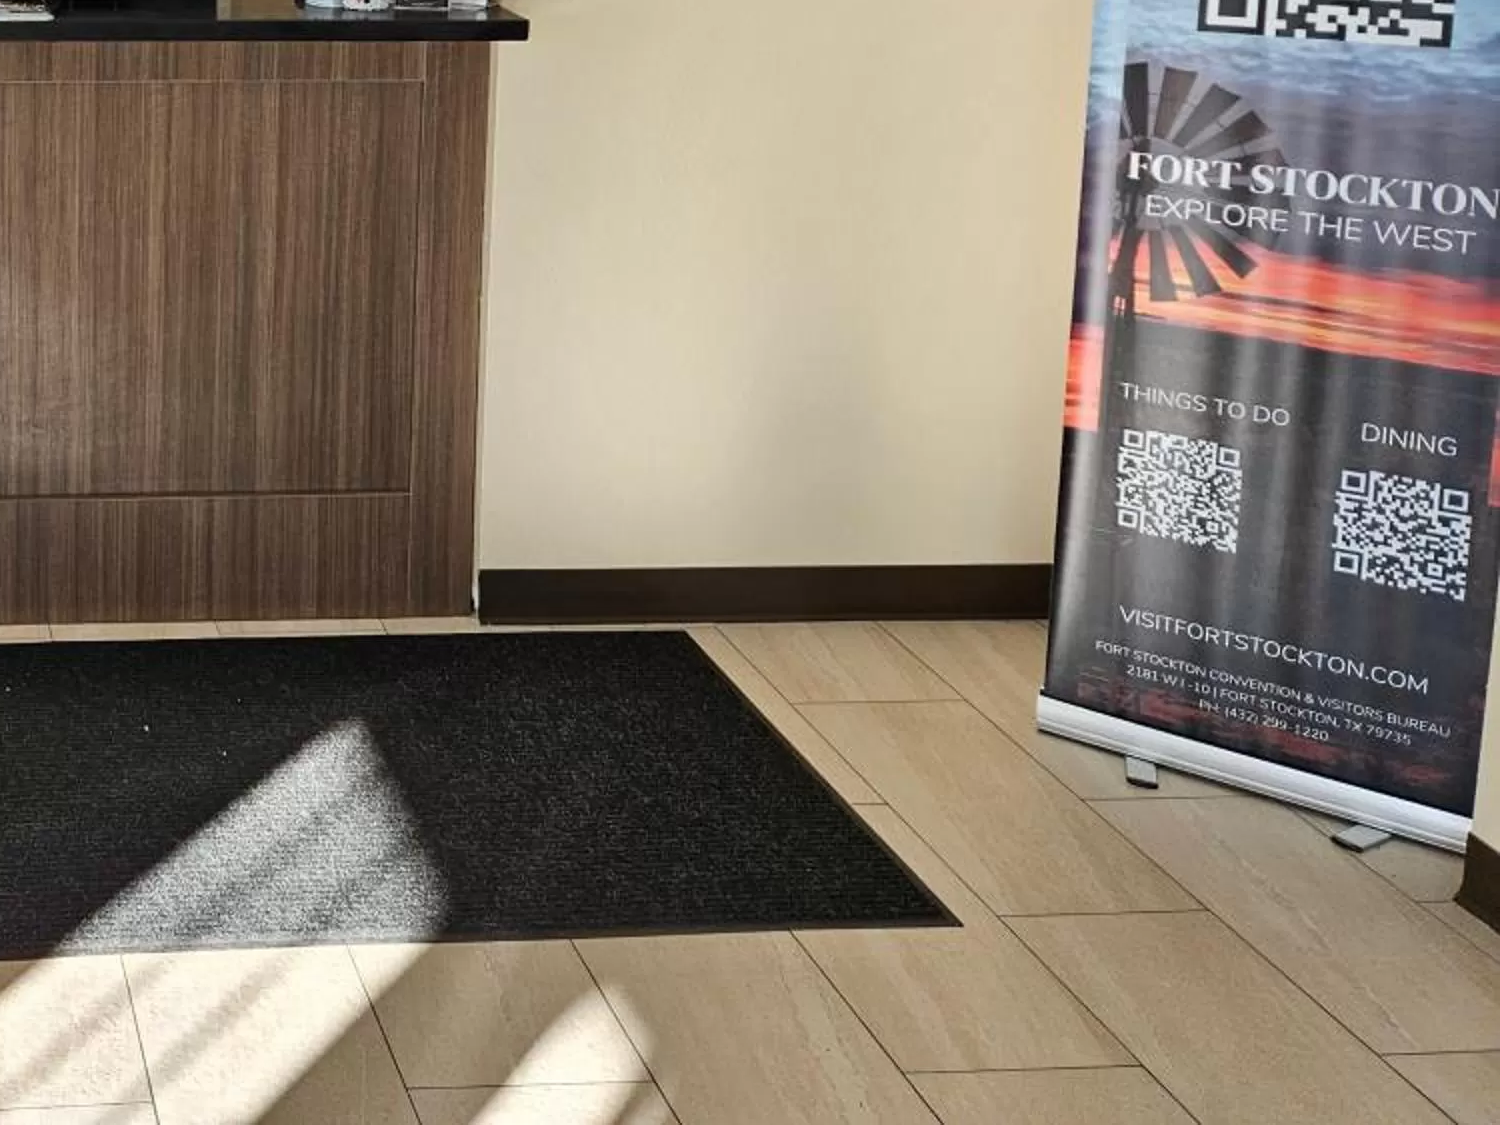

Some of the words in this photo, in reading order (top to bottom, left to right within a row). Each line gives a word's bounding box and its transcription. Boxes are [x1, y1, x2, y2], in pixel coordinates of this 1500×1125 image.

[1127, 150, 1241, 190] FORT
[1249, 163, 1500, 220] STOCKTON
[1144, 194, 1289, 233] EXPLORE
[1297, 210, 1365, 242] THE
[1373, 220, 1477, 255] WEST
[1118, 381, 1208, 413] THINGS
[1214, 397, 1247, 420] TO
[1253, 406, 1291, 427] DO
[1361, 422, 1459, 457] DINING
[1118, 604, 1429, 695] VISITFORTSTOCKTON.COM
[1095, 640, 1131, 656] FORT
[1133, 650, 1208, 676] STOCKTON
[1209, 669, 1301, 700] CONVENTION
[1317, 695, 1384, 722] VISITORS
[1387, 712, 1451, 738] BUREAU
[1219, 689, 1257, 704] FORT
